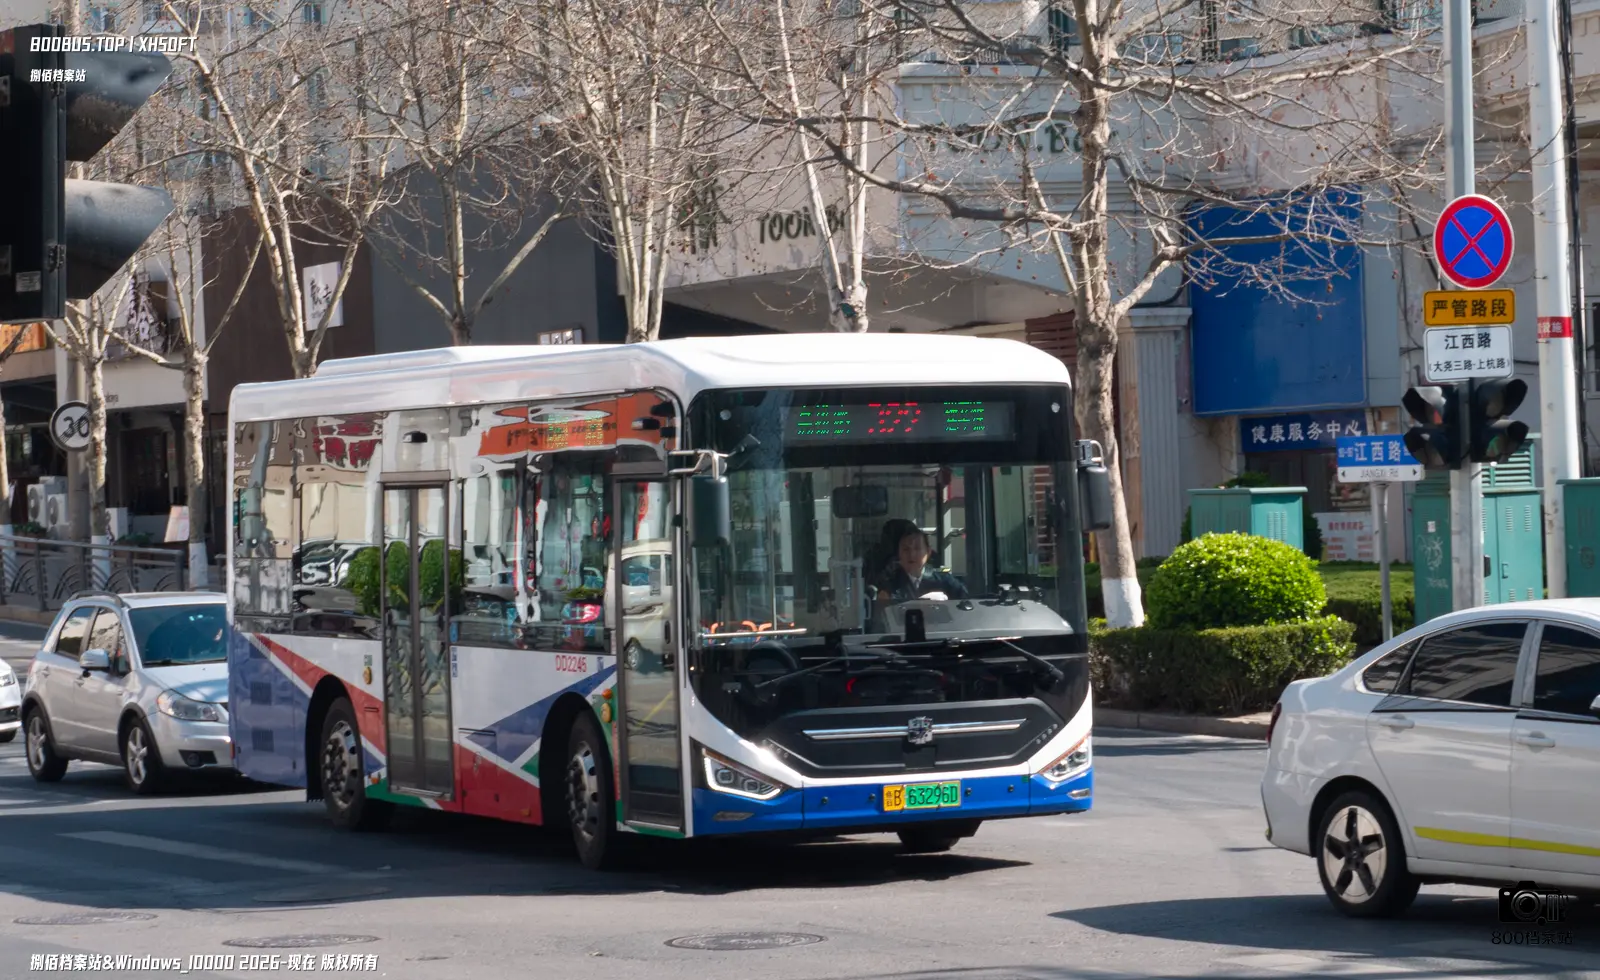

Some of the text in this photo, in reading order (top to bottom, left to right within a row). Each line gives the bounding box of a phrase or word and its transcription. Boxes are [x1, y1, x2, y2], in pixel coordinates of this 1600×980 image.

[1432, 298, 1507, 318] 严管路段
[1444, 332, 1492, 350] 江西路
[63, 416, 90, 438] 30
[1251, 420, 1363, 444] 健康服务中心
[1354, 440, 1401, 462] 江西路
